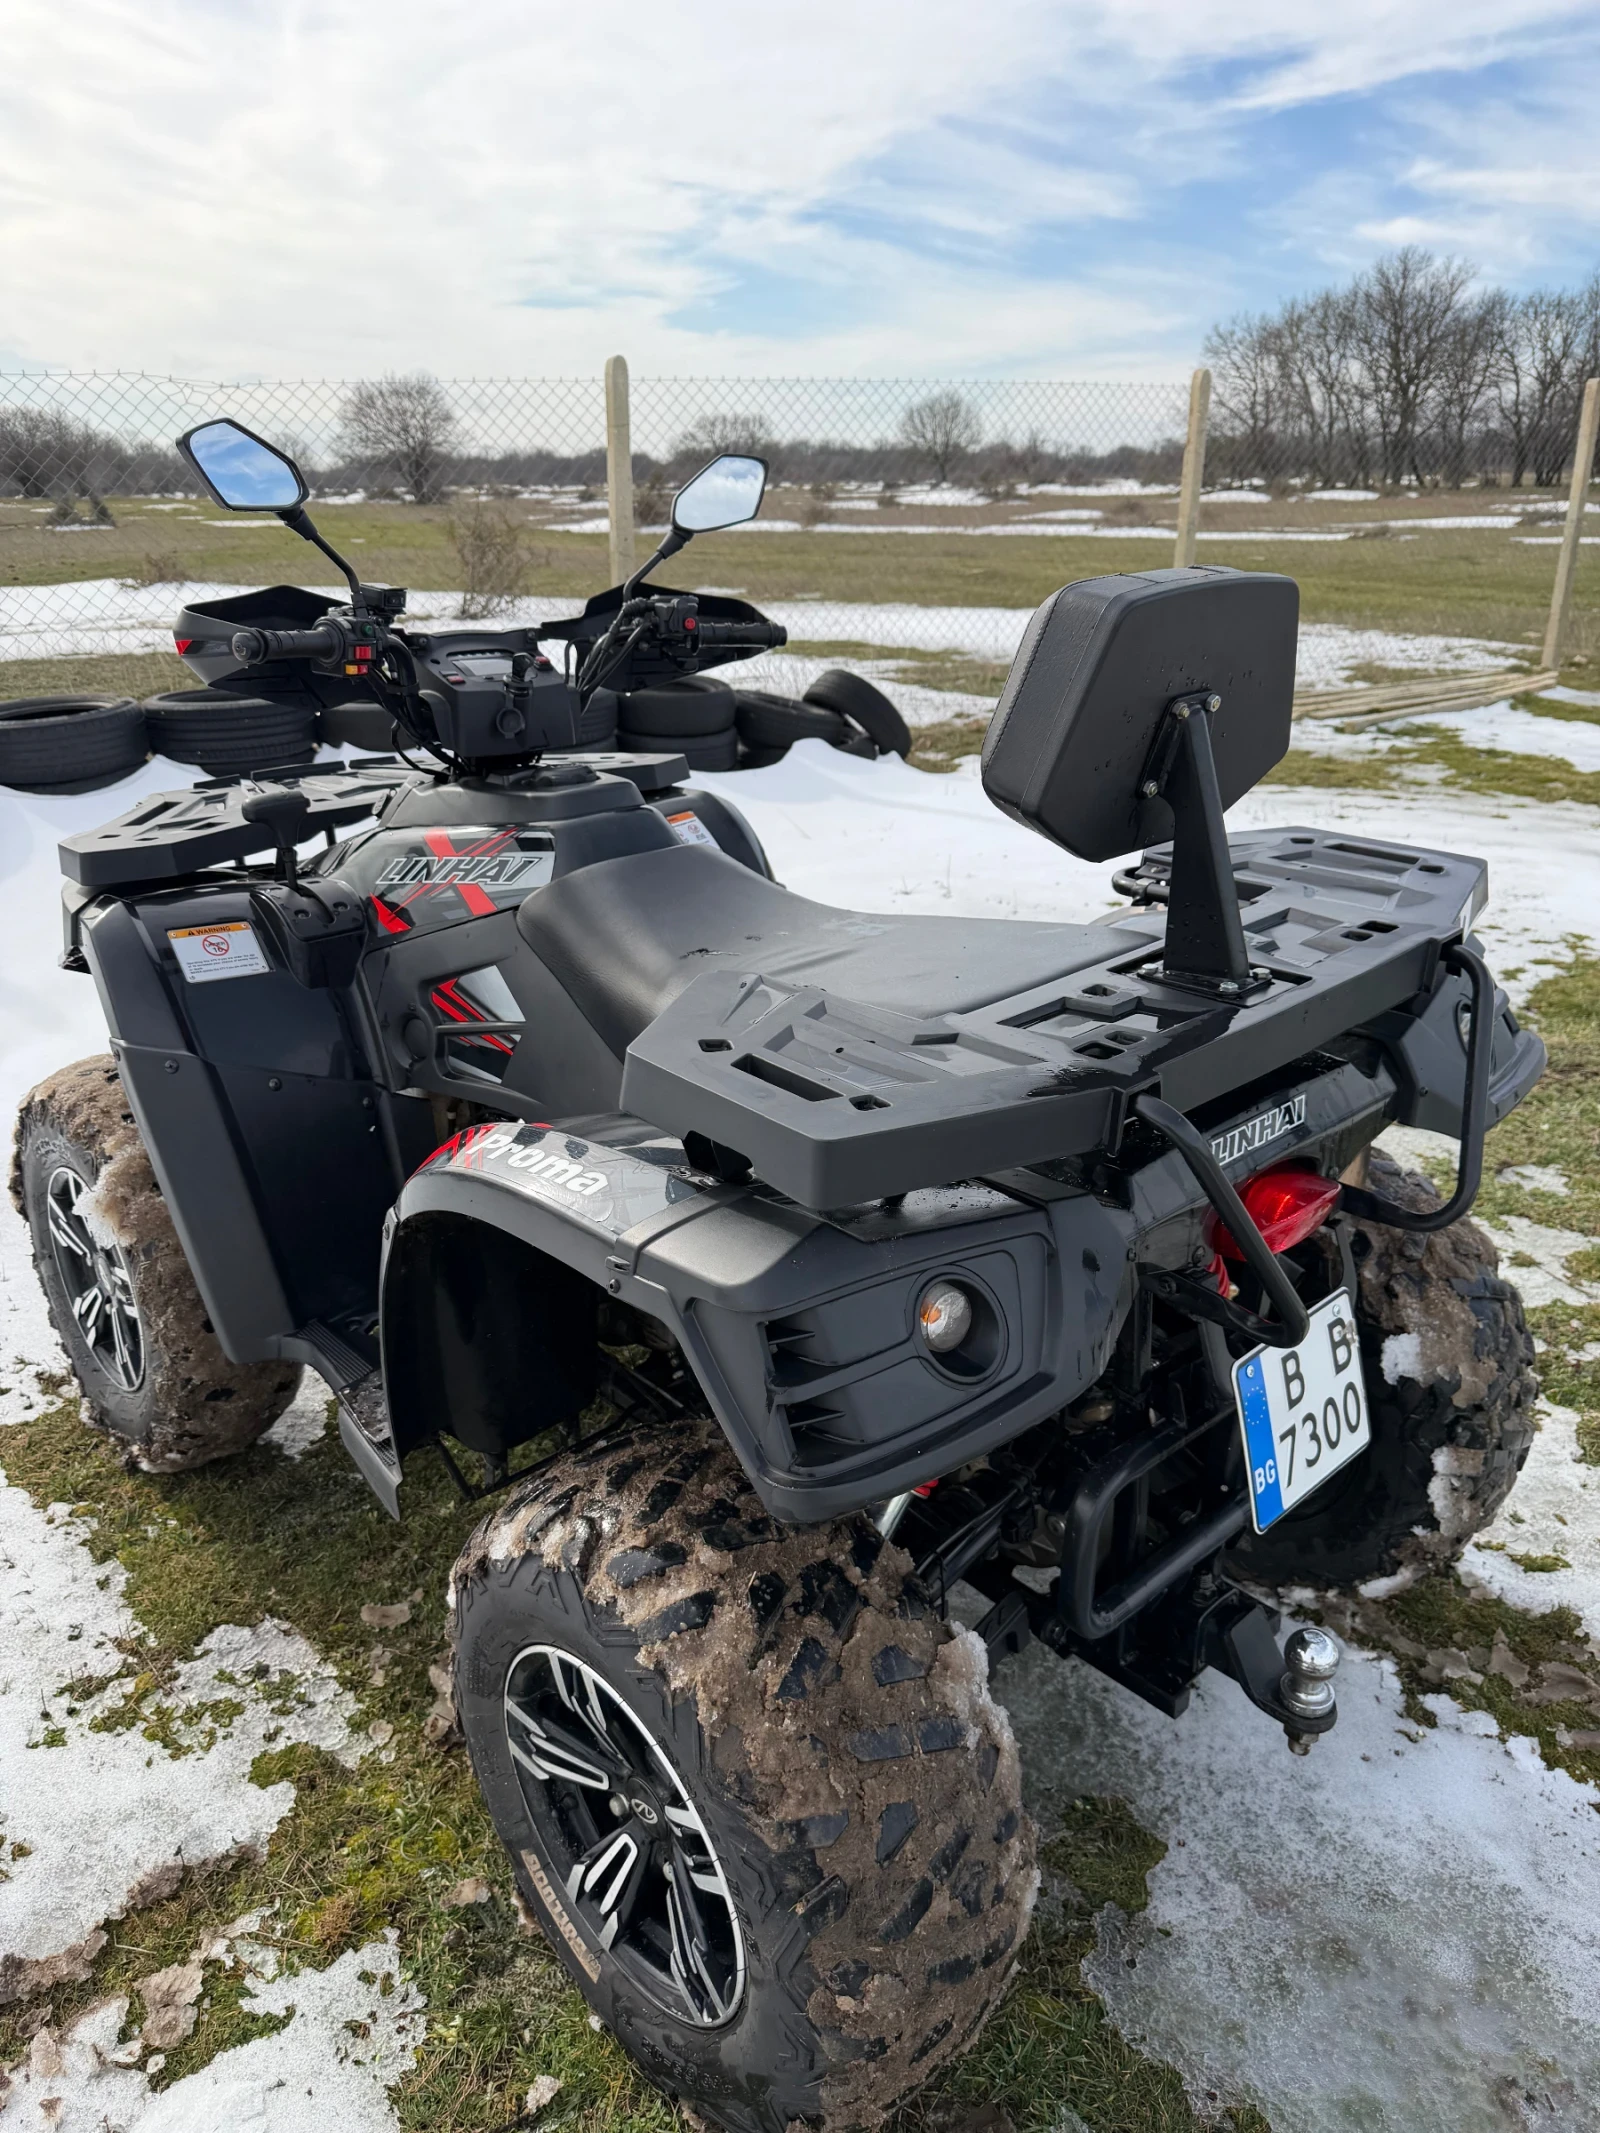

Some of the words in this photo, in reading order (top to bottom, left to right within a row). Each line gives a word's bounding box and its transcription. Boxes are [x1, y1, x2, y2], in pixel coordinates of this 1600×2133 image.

[375, 856, 543, 885] LINHAI
[195, 925, 231, 935] WARNING
[1211, 1094, 1306, 1166] LINHAI
[465, 1133, 609, 1196] Proma
[1281, 1350, 1305, 1411] B
[1327, 1317, 1352, 1376] B
[1279, 1381, 1361, 1489] 7300
[1253, 1458, 1276, 1495] BG
